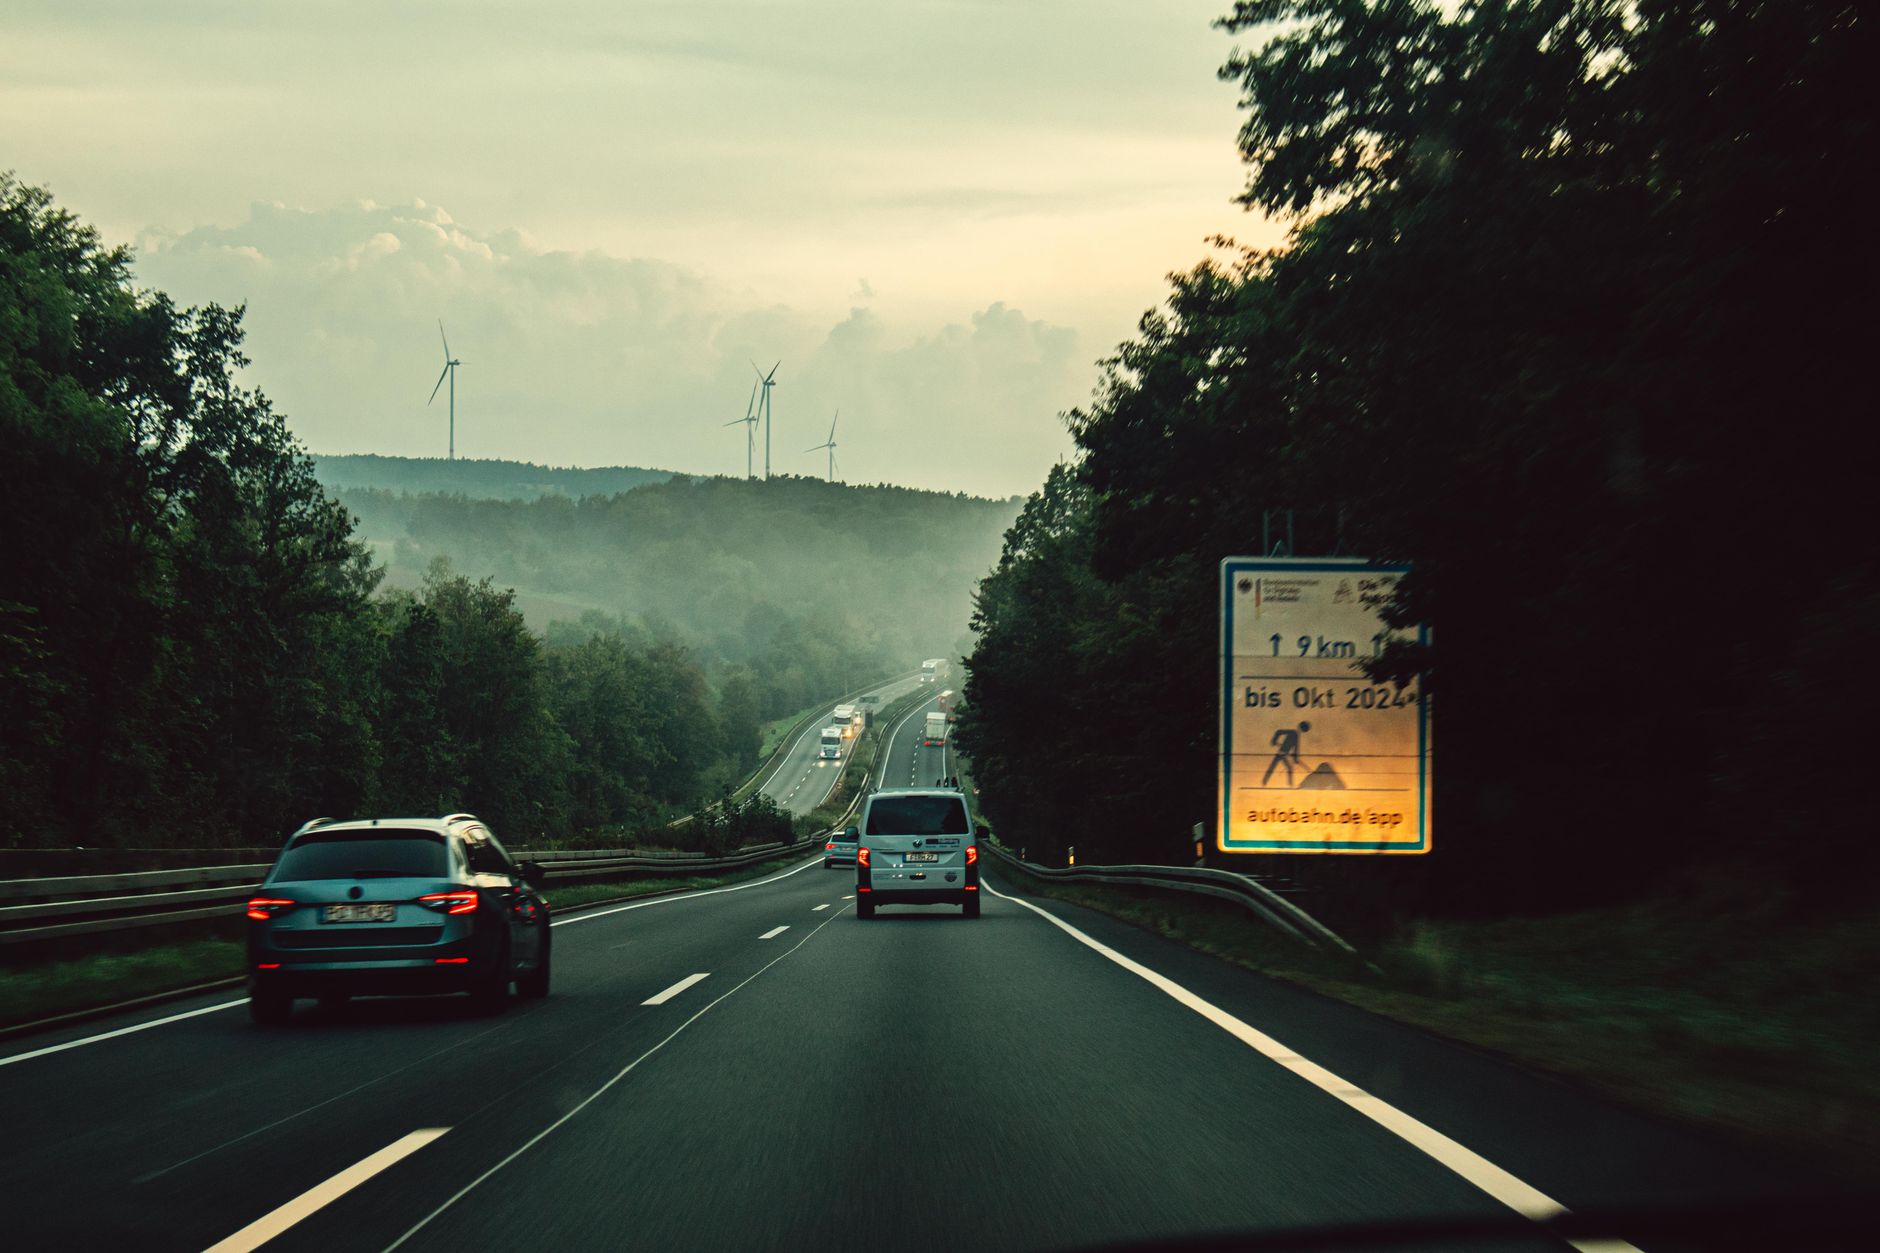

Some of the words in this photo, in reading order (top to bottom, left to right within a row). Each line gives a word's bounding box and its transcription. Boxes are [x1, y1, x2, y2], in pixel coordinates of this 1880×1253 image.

[1297, 635, 1313, 657] 9
[1316, 635, 1357, 658] km
[1245, 686, 1282, 708] bis
[1293, 686, 1336, 708] Okt
[1346, 687, 1403, 709] 2024
